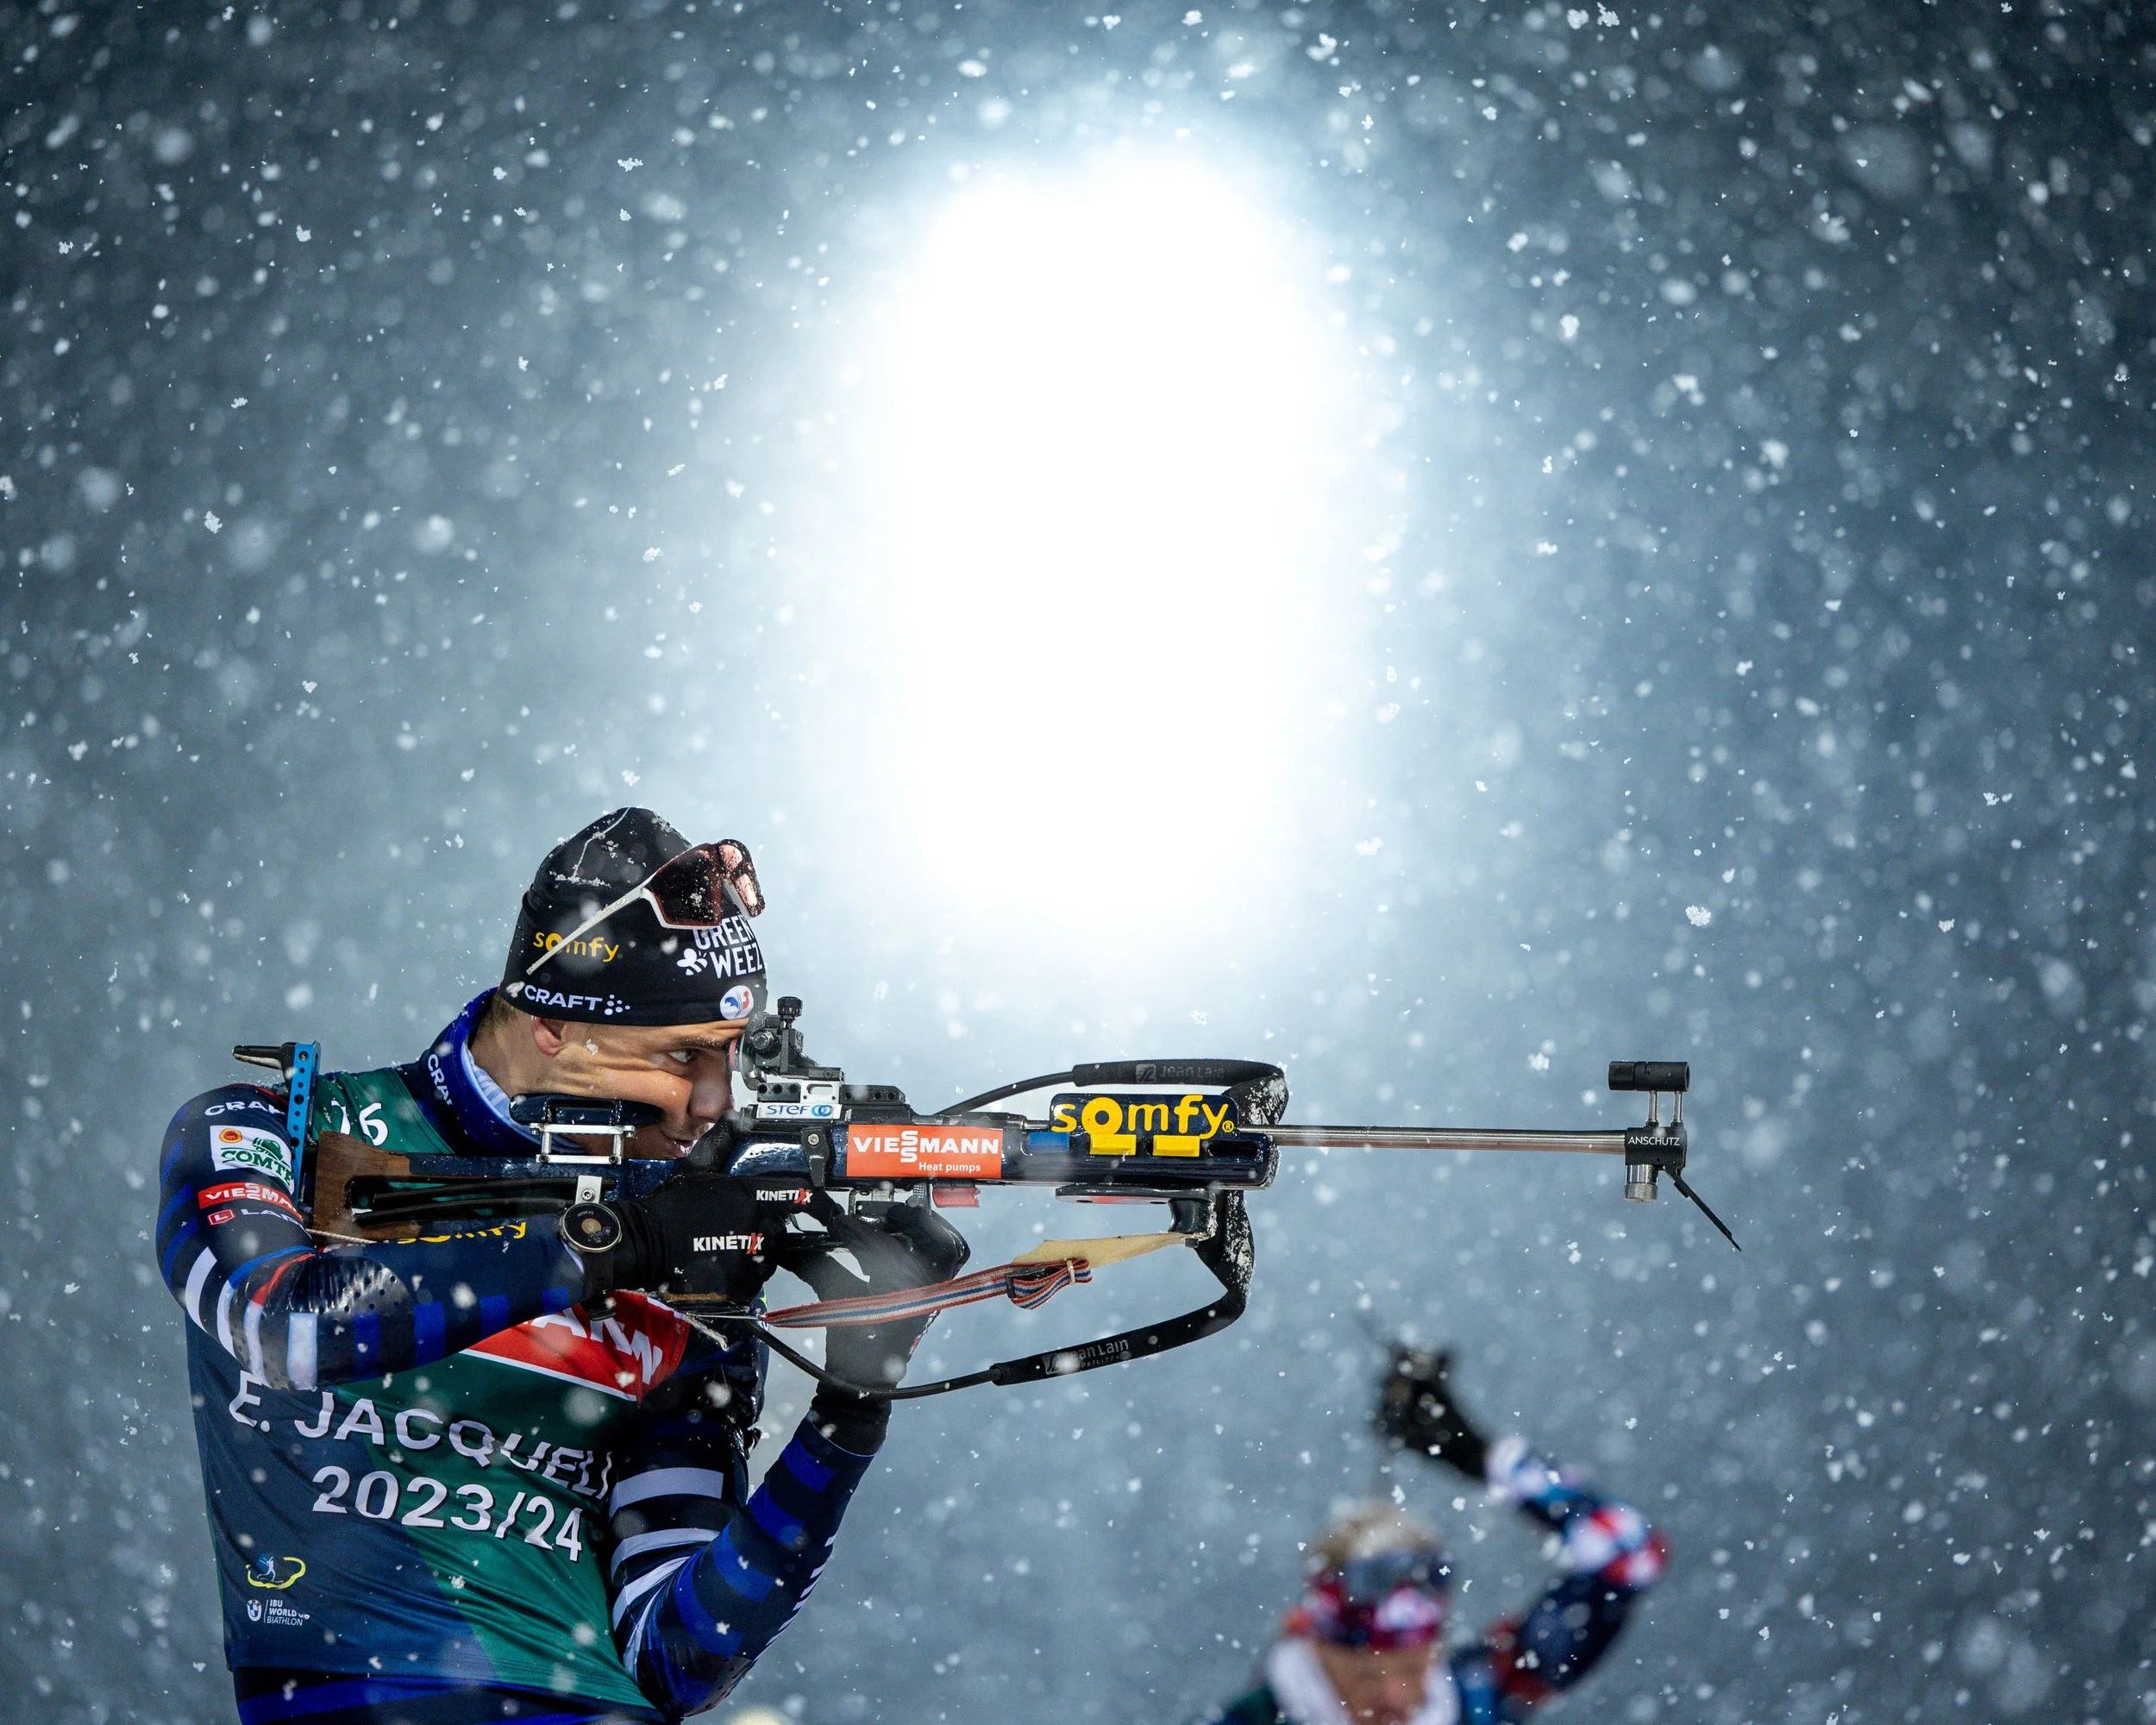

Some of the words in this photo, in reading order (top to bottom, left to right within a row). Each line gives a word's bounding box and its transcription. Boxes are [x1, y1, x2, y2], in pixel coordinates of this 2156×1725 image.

[693, 915, 755, 950] GREEN
[533, 932, 619, 962] somfy
[524, 985, 603, 1011] CRAFT
[852, 1130, 999, 1163] VIESSMANN
[918, 1162, 943, 1171] Heat
[945, 1163, 981, 1174] pumps
[1098, 1338, 1129, 1356] Lain
[229, 1370, 271, 1433] E.
[312, 1465, 584, 1562] 2023/24
[269, 1608, 298, 1617] WORLD
[270, 1599, 283, 1608] IBU
[267, 1615, 303, 1626] BIATHLON
